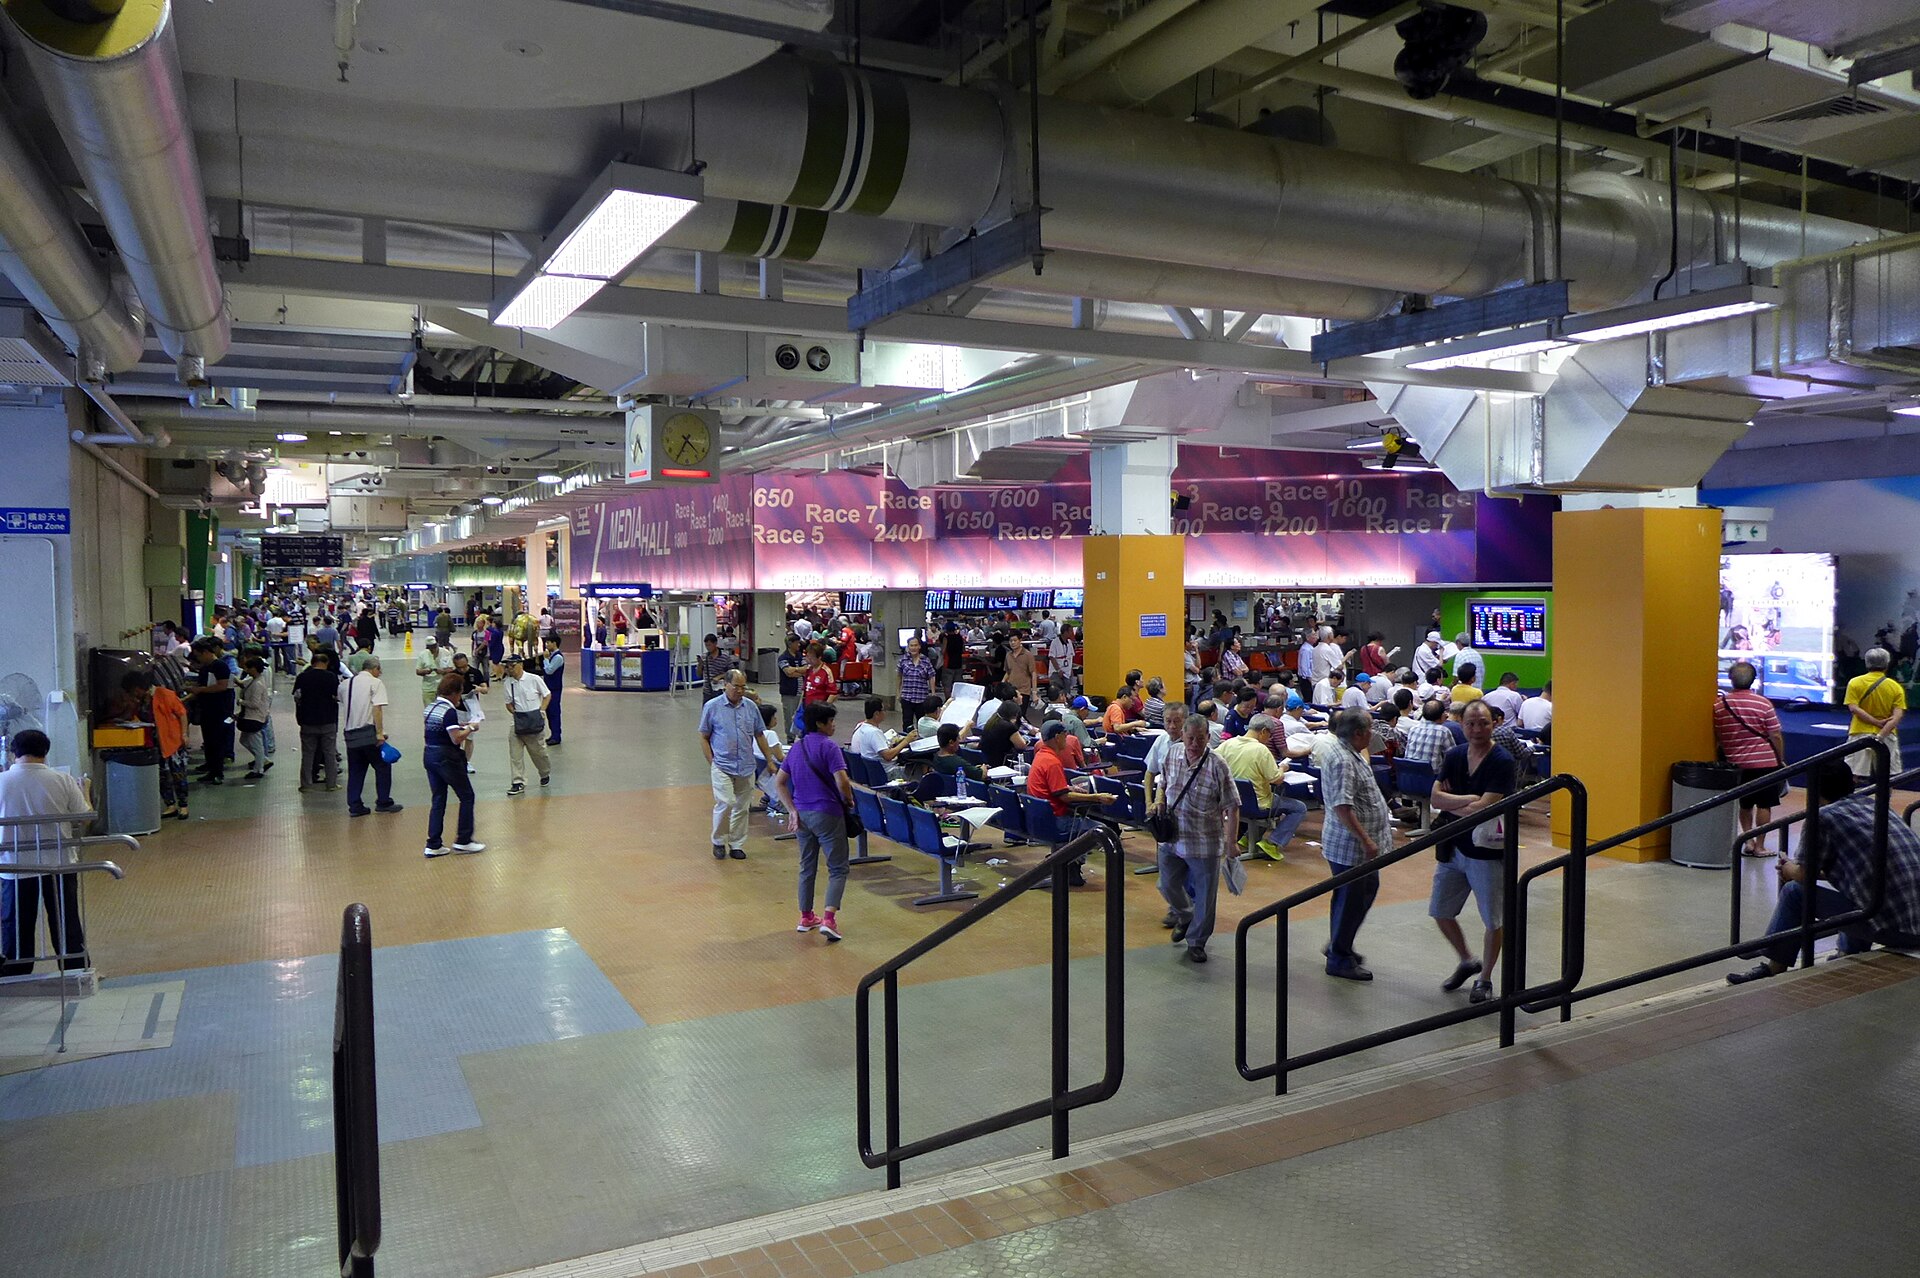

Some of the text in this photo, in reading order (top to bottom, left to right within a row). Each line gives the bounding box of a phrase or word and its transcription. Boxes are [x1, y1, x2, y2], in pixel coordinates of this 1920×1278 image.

[880, 490, 963, 510] Race 10
[988, 488, 1040, 508] 1600
[1187, 484, 1200, 503] 3
[1265, 480, 1362, 501] Race 10
[1406, 489, 1472, 509] Race
[675, 503, 690, 519] Race
[805, 503, 878, 524] Race 7
[1052, 502, 1092, 521] Rac
[1202, 501, 1284, 521] Race 9
[1328, 497, 1387, 517] 1600
[28, 522, 65, 530] Fun Zone
[690, 513, 707, 529] Race
[725, 507, 751, 529] Race 4
[945, 510, 995, 530] 1650
[1262, 516, 1319, 536] 1200
[1366, 513, 1453, 534] Race 7
[608, 505, 671, 557] MEDIA HALL
[752, 524, 825, 544] Race 5
[874, 523, 924, 543] 2400
[998, 521, 1073, 541] Race 2
[447, 552, 488, 565] court
